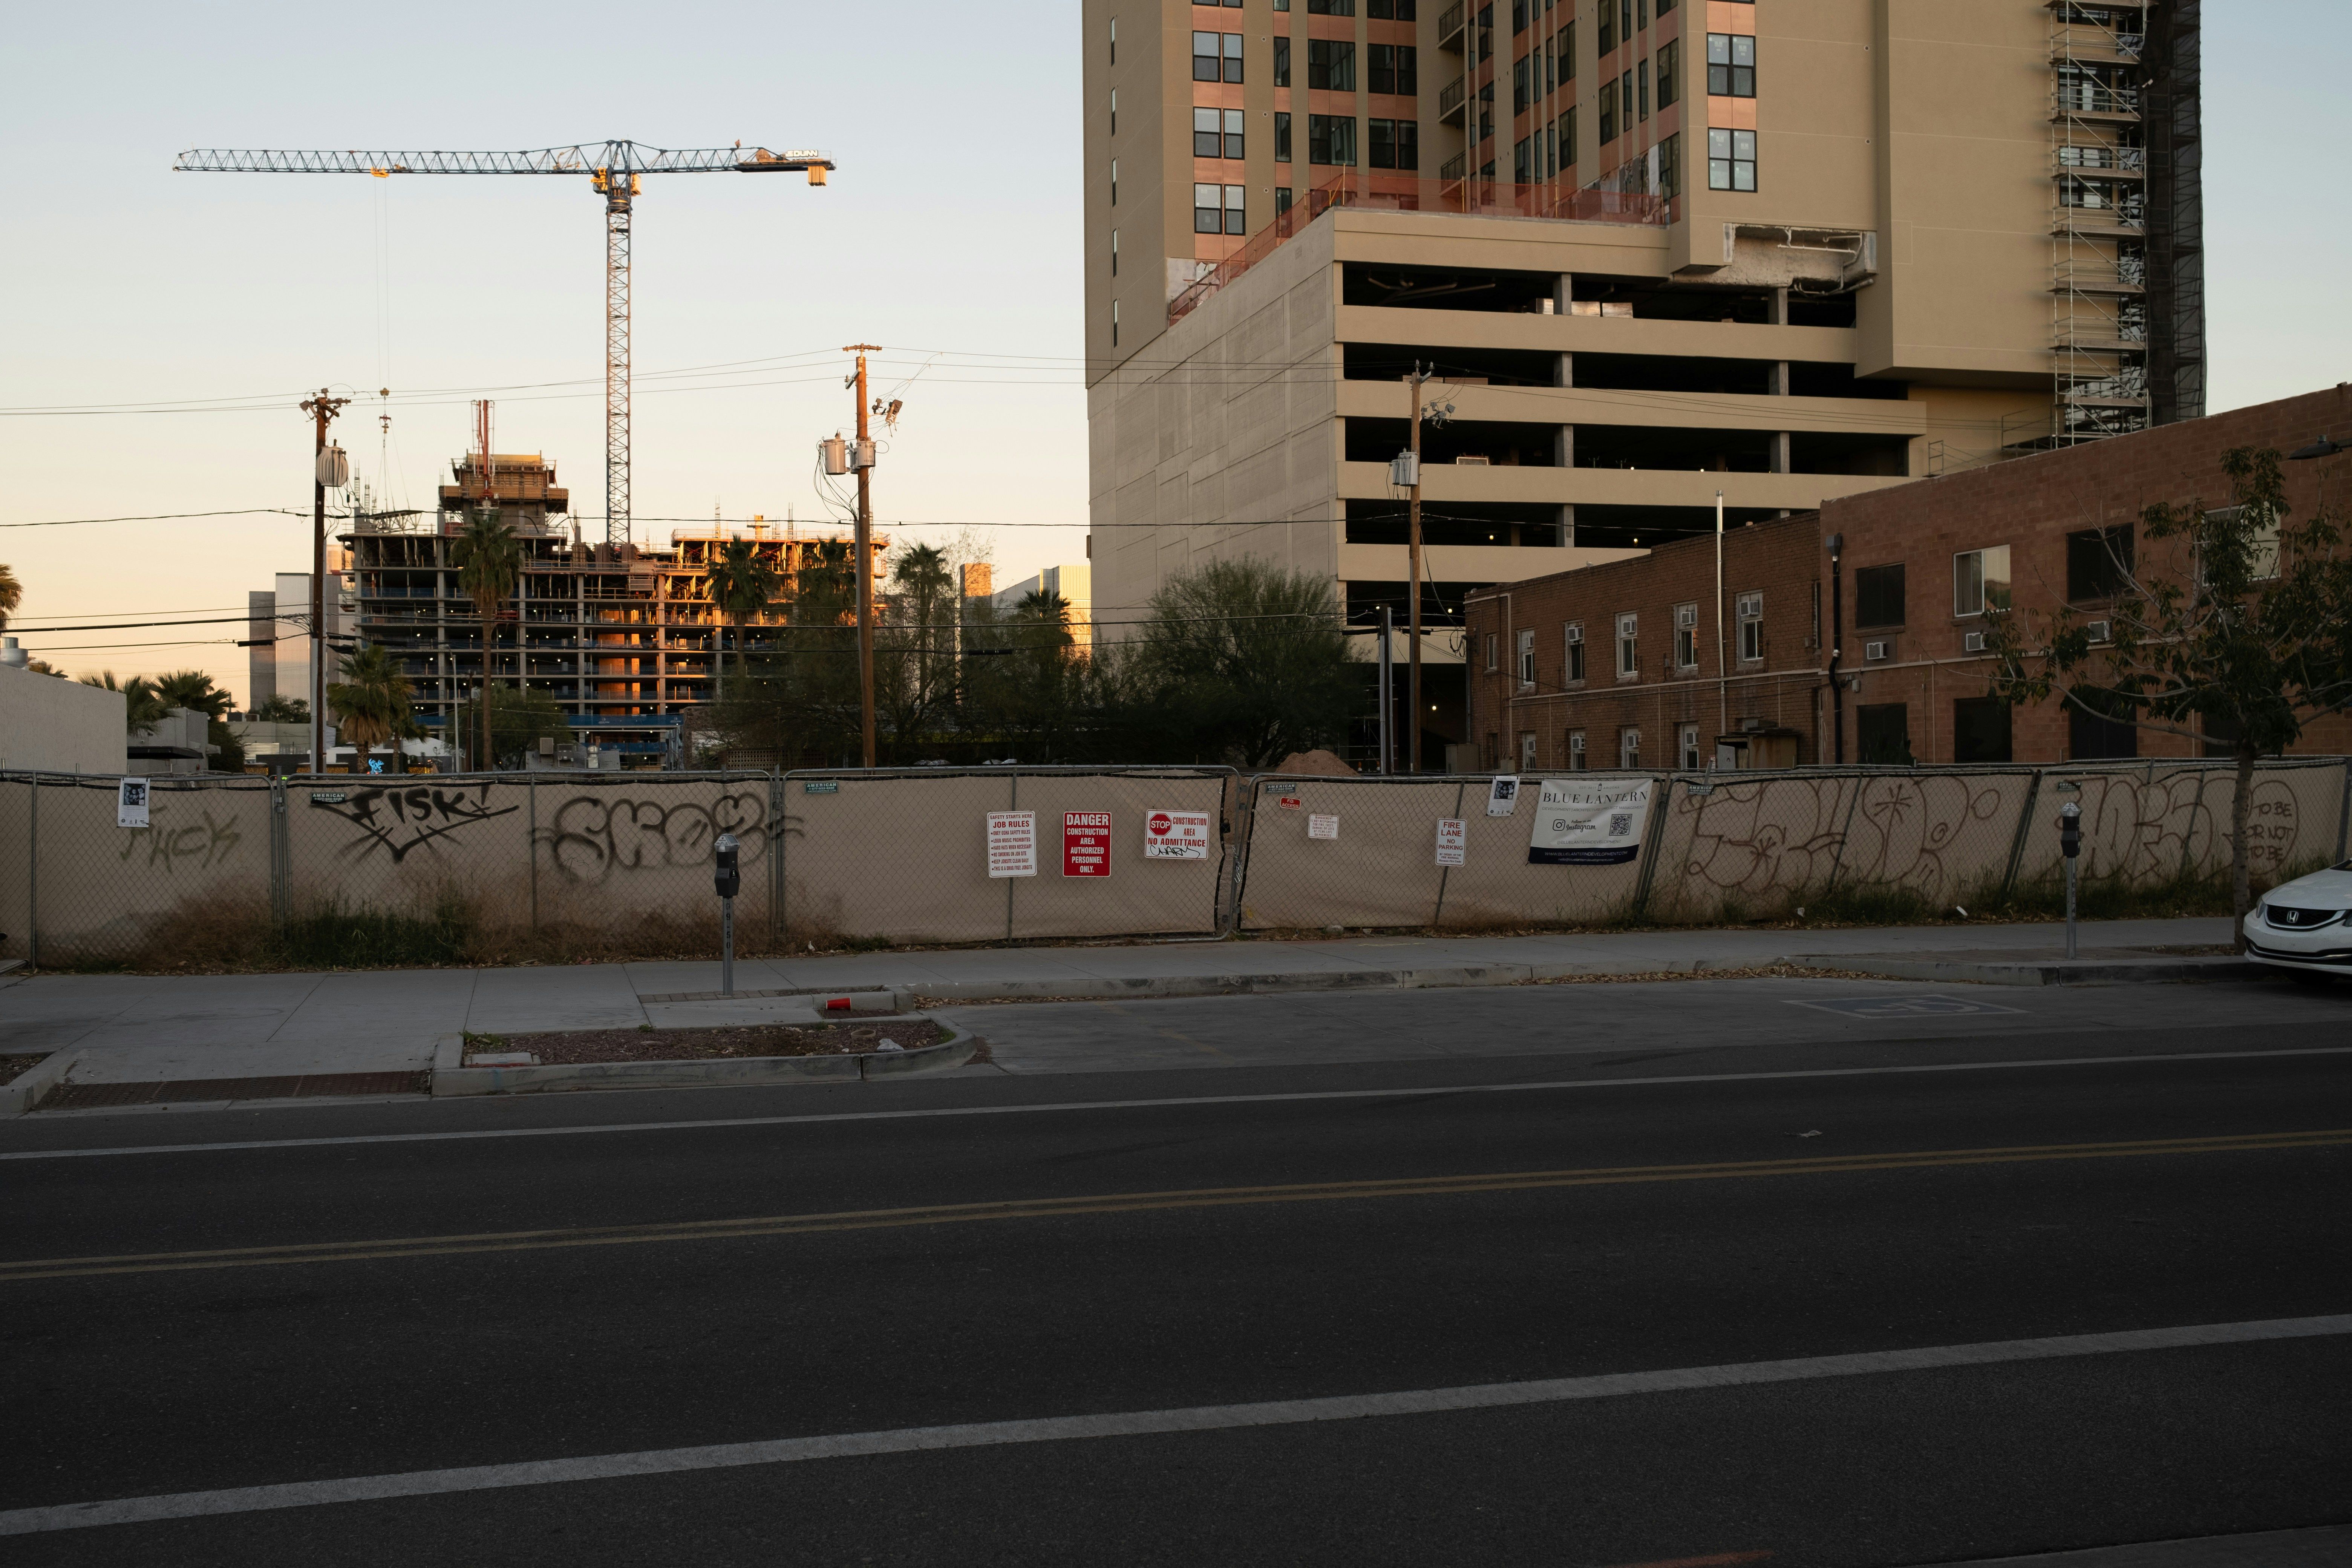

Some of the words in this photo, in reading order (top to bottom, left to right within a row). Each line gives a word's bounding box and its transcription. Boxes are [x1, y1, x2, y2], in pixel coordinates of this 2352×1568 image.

[1543, 792, 1580, 803] BLUE
[1585, 791, 1648, 804] LANTERN
[2252, 803, 2271, 817] TO
[2274, 801, 2292, 817] BE
[1067, 814, 1109, 825] DANGER
[1173, 817, 1207, 825] CONSTRUCTION
[2268, 825, 2294, 842] NOT
[1161, 838, 1205, 847] ADMITTANCE
[2247, 845, 2265, 859] TO
[2266, 845, 2283, 861] BE
